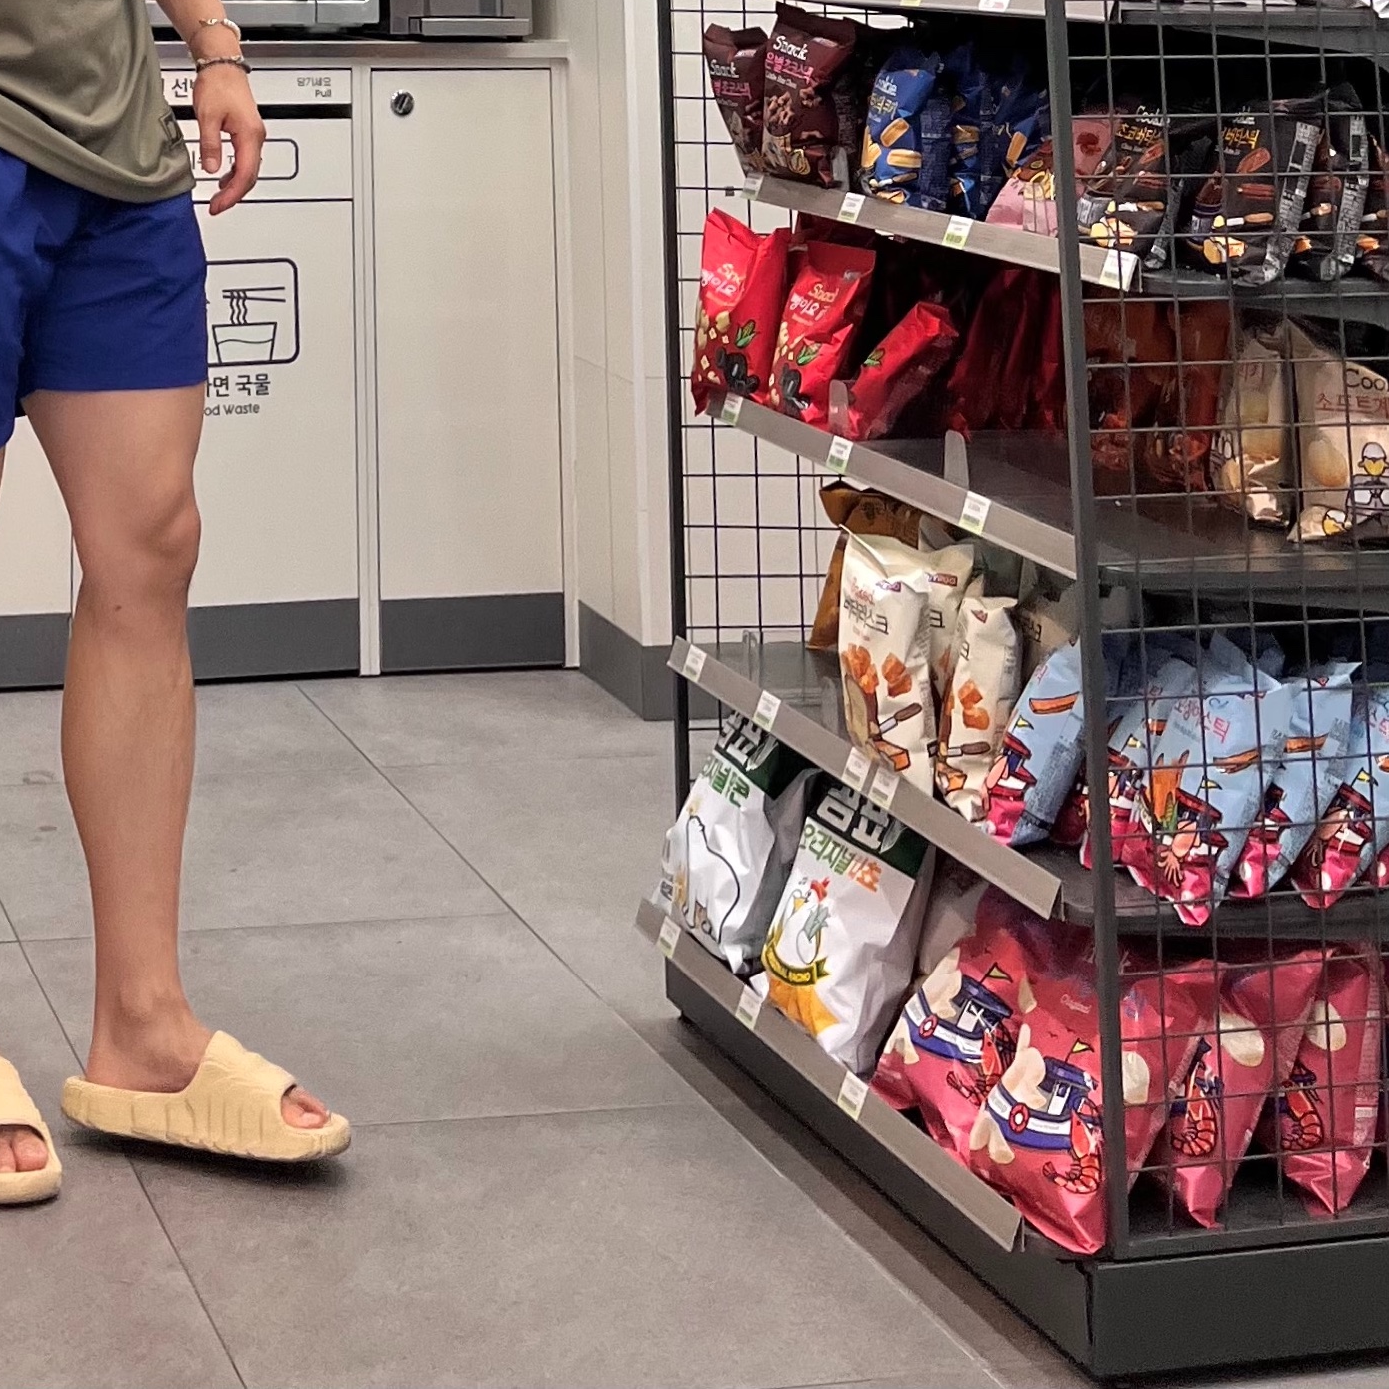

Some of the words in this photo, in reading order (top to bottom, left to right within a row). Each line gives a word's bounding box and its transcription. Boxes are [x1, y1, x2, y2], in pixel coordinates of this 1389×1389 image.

[773, 35, 808, 61] Snack
[235, 373, 271, 396] 국물
[222, 403, 261, 416] Waste
